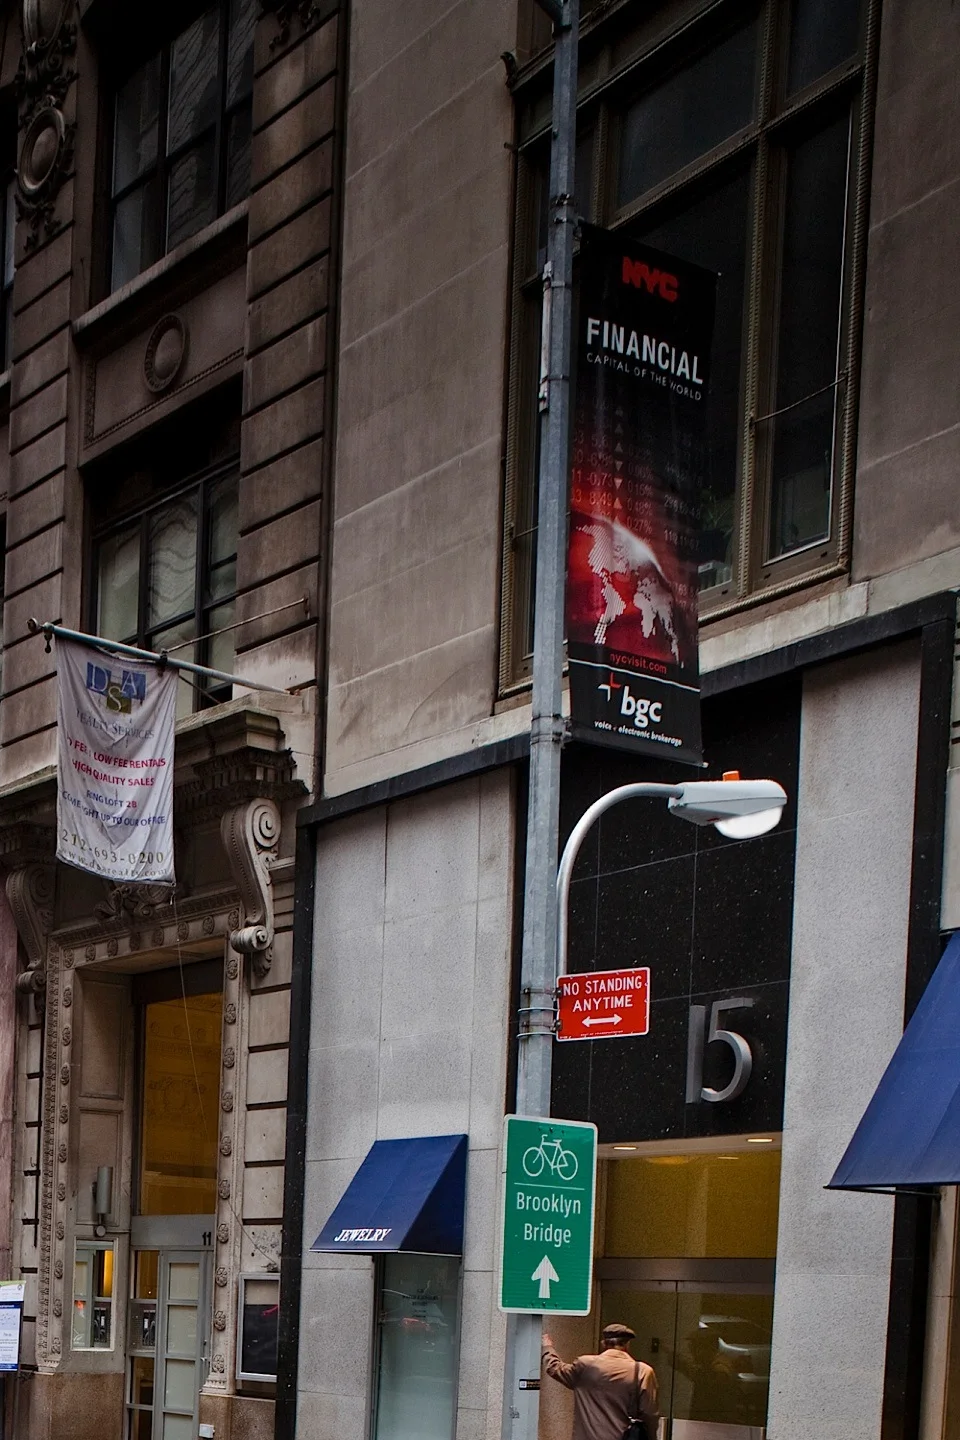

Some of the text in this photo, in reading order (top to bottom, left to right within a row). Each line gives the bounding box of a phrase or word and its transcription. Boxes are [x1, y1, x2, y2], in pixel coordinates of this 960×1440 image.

[622, 256, 679, 302] NYC
[586, 317, 703, 385] FINANCIAL
[586, 352, 702, 401] CAPITAL OF THE WORLD
[610, 653, 667, 674] nycvisit.com
[621, 686, 662, 728] bgc
[112, 723, 154, 739] SERVICES
[594, 720, 683, 747] voice electronic brokerage
[93, 751, 113, 765] LOW
[113, 757, 128, 768] FEE
[128, 778, 155, 786] SALES
[105, 797, 123, 808] LOFT
[100, 811, 111, 822] UP
[112, 816, 123, 825] TO
[124, 817, 139, 826] OUR
[62, 829, 164, 864] 212-693-0200
[563, 976, 642, 996] NO STANDING
[572, 994, 633, 1013] ANYTIME
[685, 997, 756, 1104] 15
[516, 1191, 581, 1218] Brooklyn
[202, 1231, 212, 1246] 11
[334, 1228, 392, 1242] JEWELRY
[523, 1222, 572, 1248] Bridge
